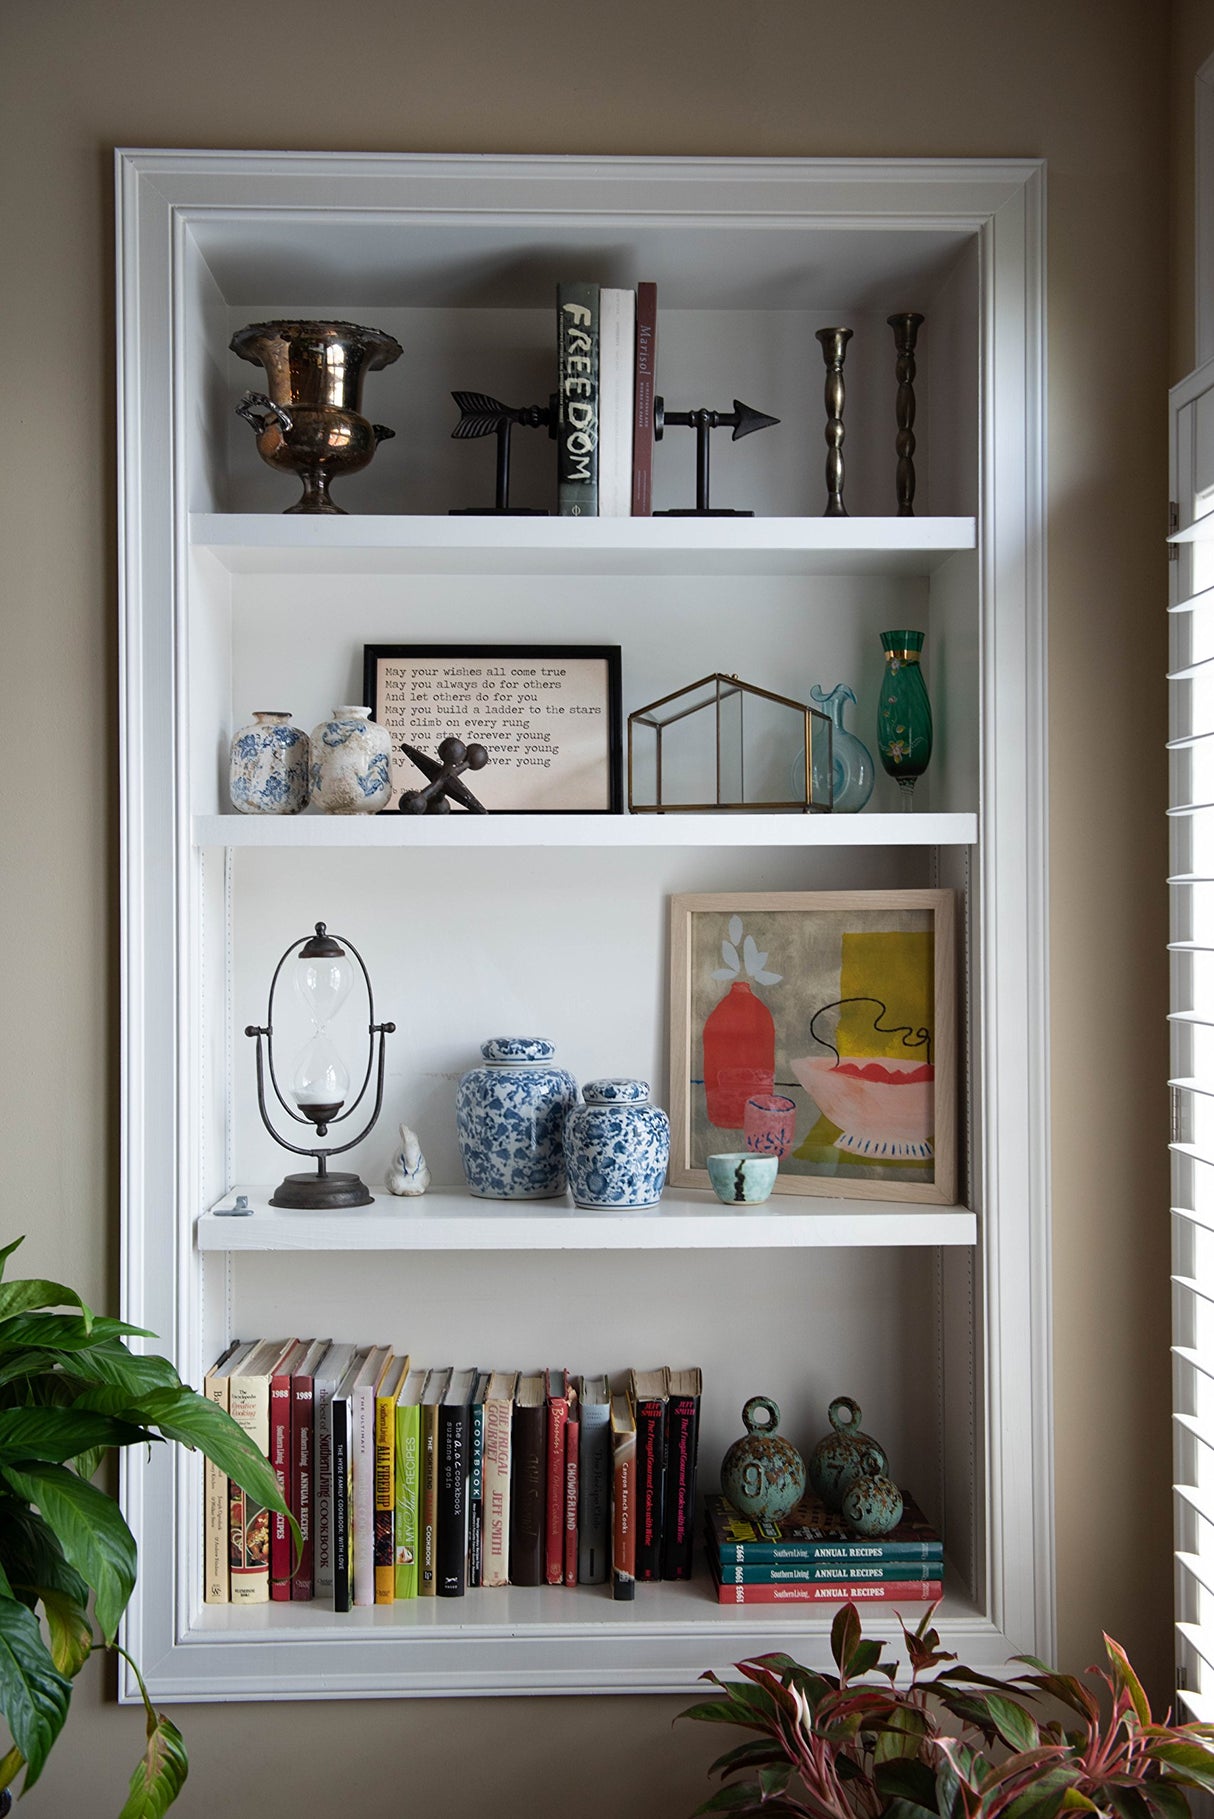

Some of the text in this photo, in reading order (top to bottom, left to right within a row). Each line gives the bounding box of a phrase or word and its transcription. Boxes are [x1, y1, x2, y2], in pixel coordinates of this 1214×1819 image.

[640, 325, 652, 376] Marisol
[563, 303, 592, 480] FREEDOM
[385, 668, 406, 678] May
[411, 669, 438, 678] your
[385, 680, 561, 690] May you always do for others
[385, 692, 537, 703] And let others do for you
[385, 706, 405, 716] May
[411, 707, 432, 716] you
[385, 718, 405, 726] And
[410, 718, 441, 726] climb
[465, 720, 496, 729] every
[503, 720, 530, 729] rung
[411, 732, 431, 742] you
[467, 730, 511, 738] forever
[516, 732, 551, 742] young
[525, 745, 559, 754] young
[392, 758, 405, 767] ay
[516, 758, 551, 767] young
[272, 1388, 288, 1398] 1988
[296, 1392, 312, 1400] 1989
[320, 1389, 328, 1402] the
[320, 1403, 328, 1418] best
[320, 1420, 328, 1430] of
[552, 1408, 564, 1454] Brennan's
[648, 1420, 656, 1432] The
[276, 1425, 285, 1448] Southern
[487, 1405, 498, 1464] GOURMET
[498, 1404, 508, 1476] THE FRUGAL
[679, 1430, 688, 1454] Frugal
[319, 1434, 332, 1472] Southern
[646, 1432, 654, 1456] Frugal
[276, 1450, 285, 1465] Living
[378, 1404, 391, 1507] Southern Living ALL FIRED UP
[406, 1437, 416, 1484] RECIPES
[299, 1427, 309, 1541] Southern Living ANNUAL RECIPES
[445, 1466, 453, 1488] goin
[621, 1462, 629, 1488] Canyon
[742, 1463, 762, 1498] 9
[317, 1472, 332, 1497] Living
[454, 1470, 462, 1516] cookbook
[566, 1462, 576, 1531] CHOWDERLAND
[678, 1488, 686, 1509] Cooks
[276, 1512, 285, 1539] ECIPES
[492, 1490, 502, 1556] JEFF SMITH
[406, 1526, 414, 1542] MY
[736, 1544, 744, 1562] 1992
[773, 1549, 794, 1558] Southern
[814, 1548, 848, 1557] ANNUAL
[850, 1548, 883, 1556] RECIPES
[736, 1566, 744, 1583] 1990
[770, 1569, 884, 1579] Southern Living ANNUAL RECIPES
[736, 1586, 744, 1603] 1993
[774, 1590, 794, 1598] Southern
[814, 1589, 848, 1597] ANNUAL
[850, 1588, 884, 1596] RECIPES
